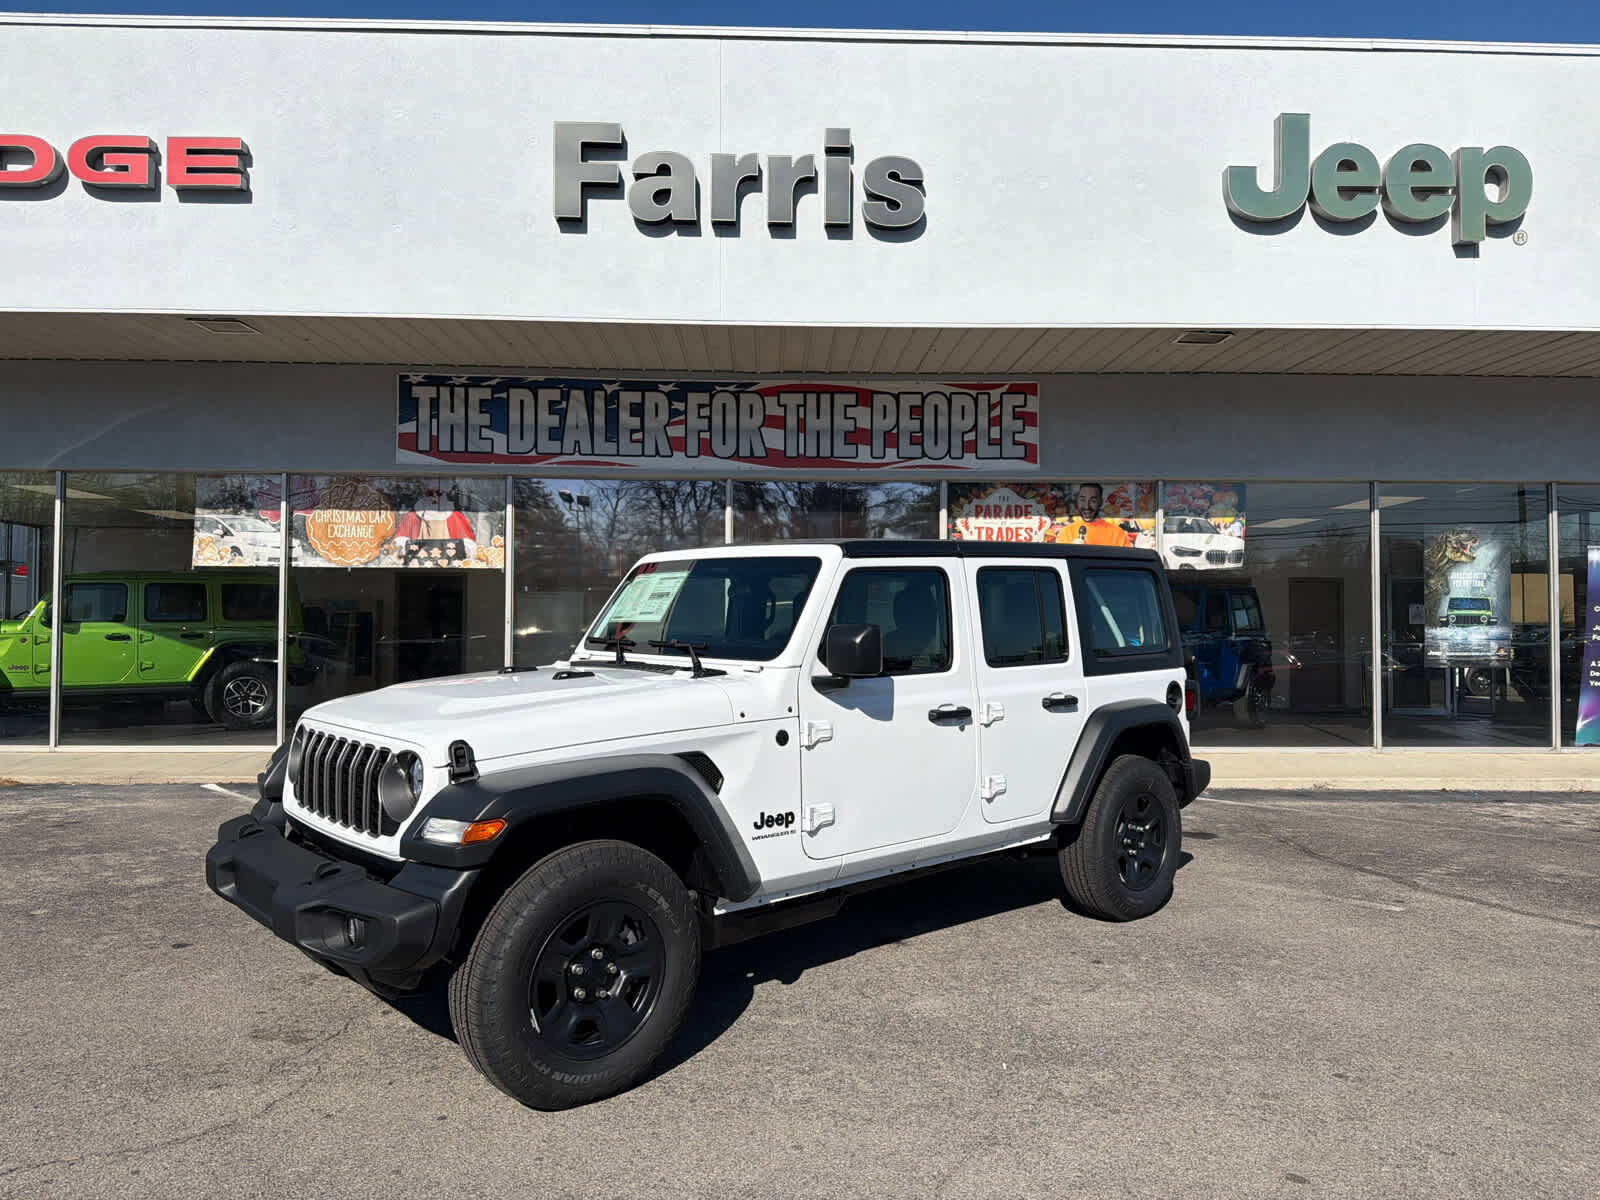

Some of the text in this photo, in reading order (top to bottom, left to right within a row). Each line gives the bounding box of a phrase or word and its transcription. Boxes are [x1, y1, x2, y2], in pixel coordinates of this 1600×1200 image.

[553, 121, 926, 232] Farris
[1222, 112, 1533, 244] Jeep
[411, 385, 1028, 460] THE DEALER FOR THE PEOPLE
[315, 509, 388, 524] CHRISTMAS CAR
[974, 504, 1033, 520] PARADE
[327, 523, 375, 539] EXCHANGE
[974, 526, 1034, 542] TRADES
[753, 811, 795, 830] Jeep
